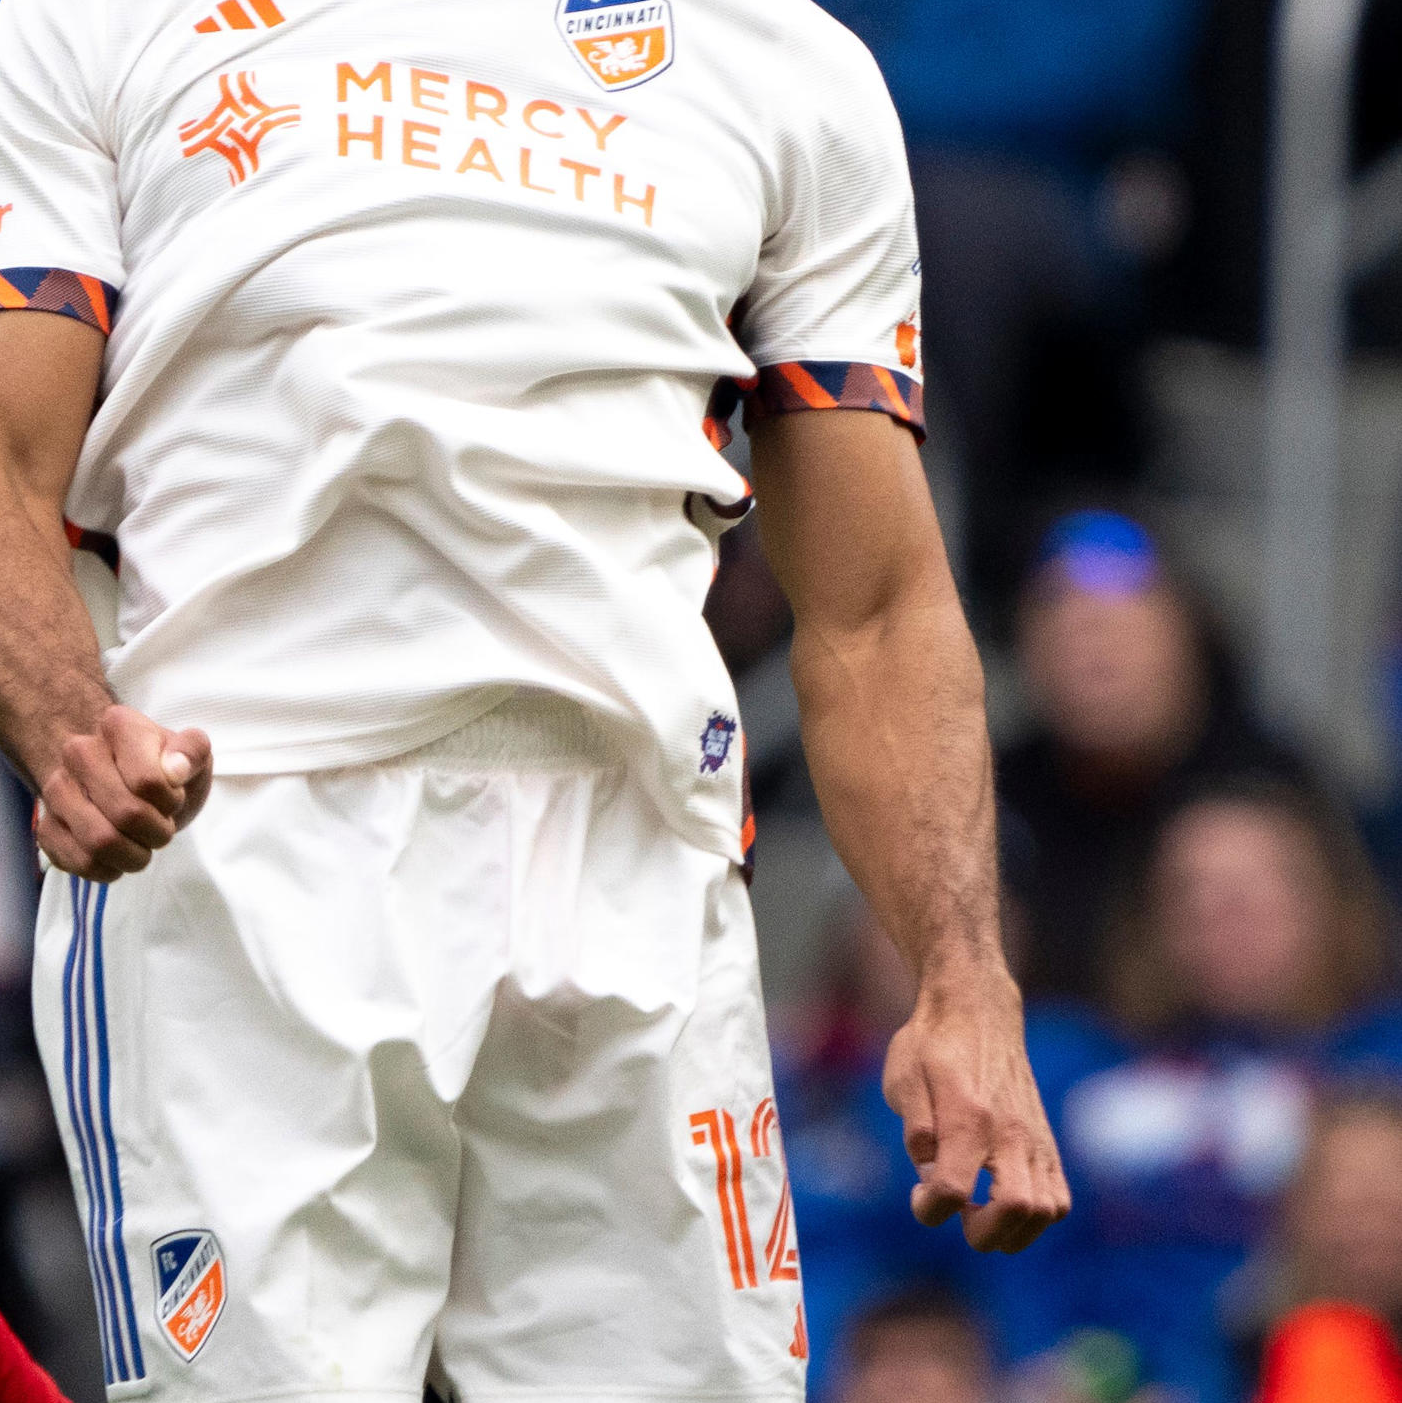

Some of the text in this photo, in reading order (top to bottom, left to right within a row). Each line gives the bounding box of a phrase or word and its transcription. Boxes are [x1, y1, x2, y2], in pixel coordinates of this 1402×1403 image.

[566, 5, 664, 34] CINCINNATI
[336, 61, 629, 151] MERCY
[336, 113, 657, 228] HEALTH
[688, 1096, 799, 1290] 12
